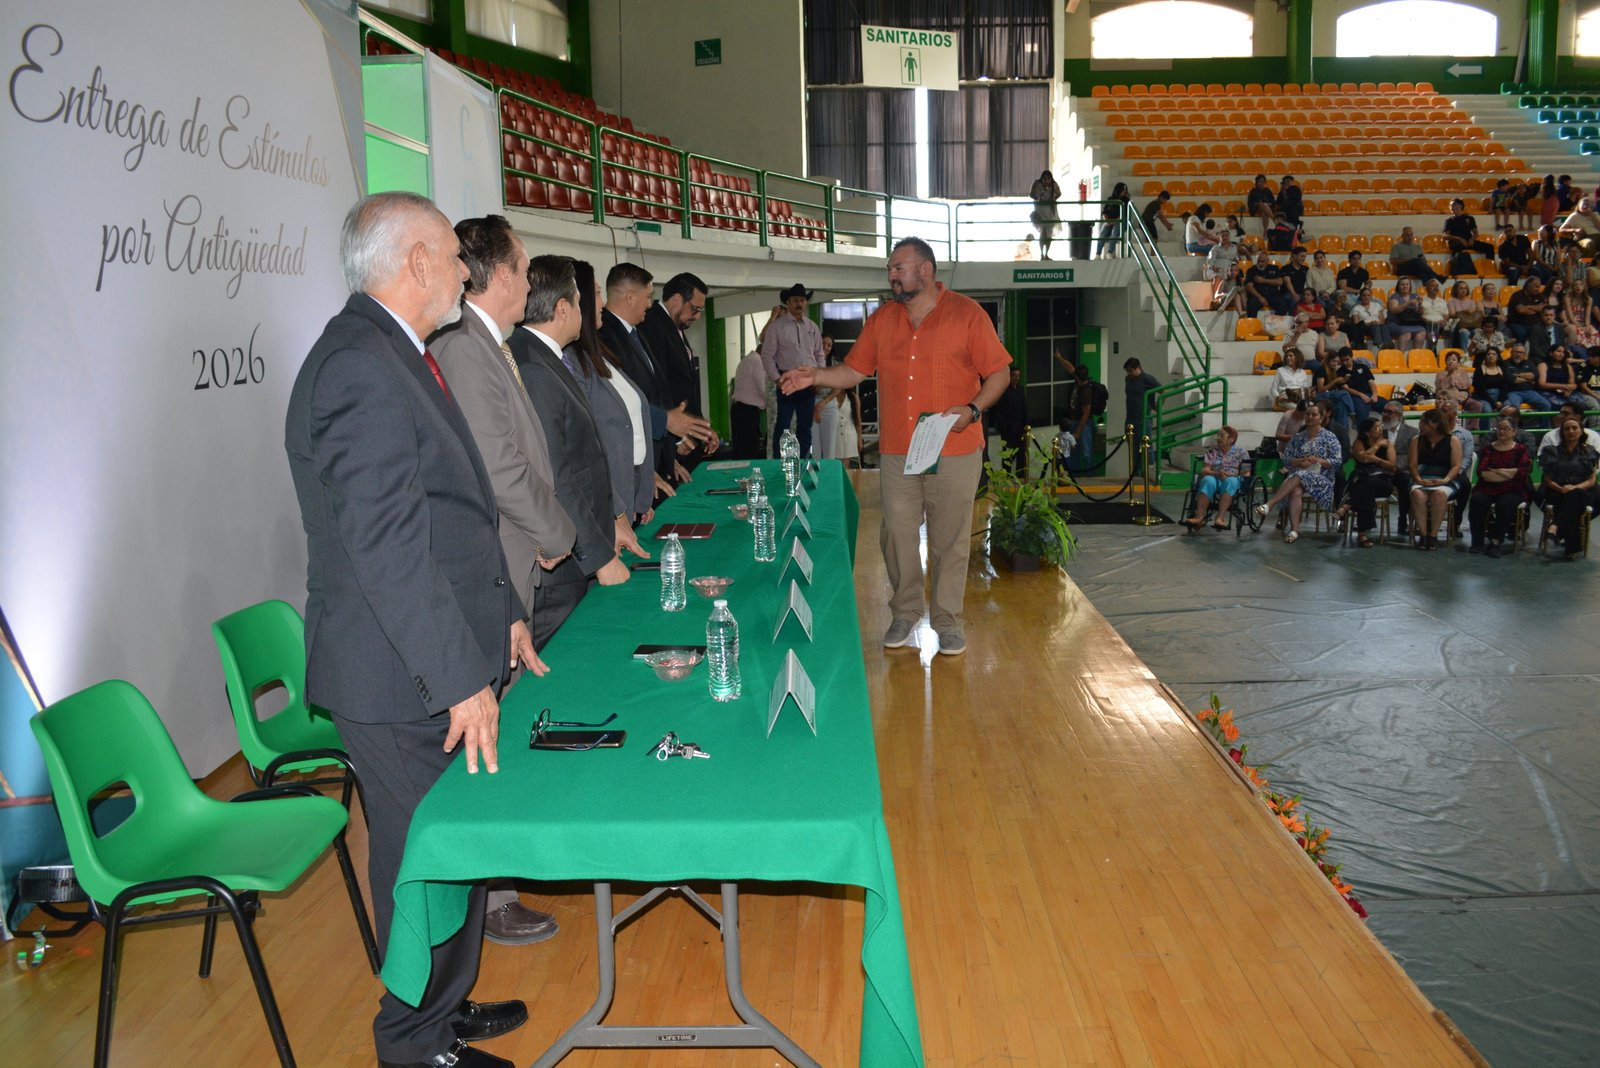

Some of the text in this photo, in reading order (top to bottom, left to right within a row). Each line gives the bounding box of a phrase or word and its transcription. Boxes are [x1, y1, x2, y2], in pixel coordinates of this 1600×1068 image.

[866, 27, 952, 48] SANITARIOS
[9, 24, 330, 187] Entrega de Estímulos
[96, 194, 308, 300] por Antigüedad
[1017, 272, 1064, 280] SANITARIOS
[192, 323, 265, 391] 2026
